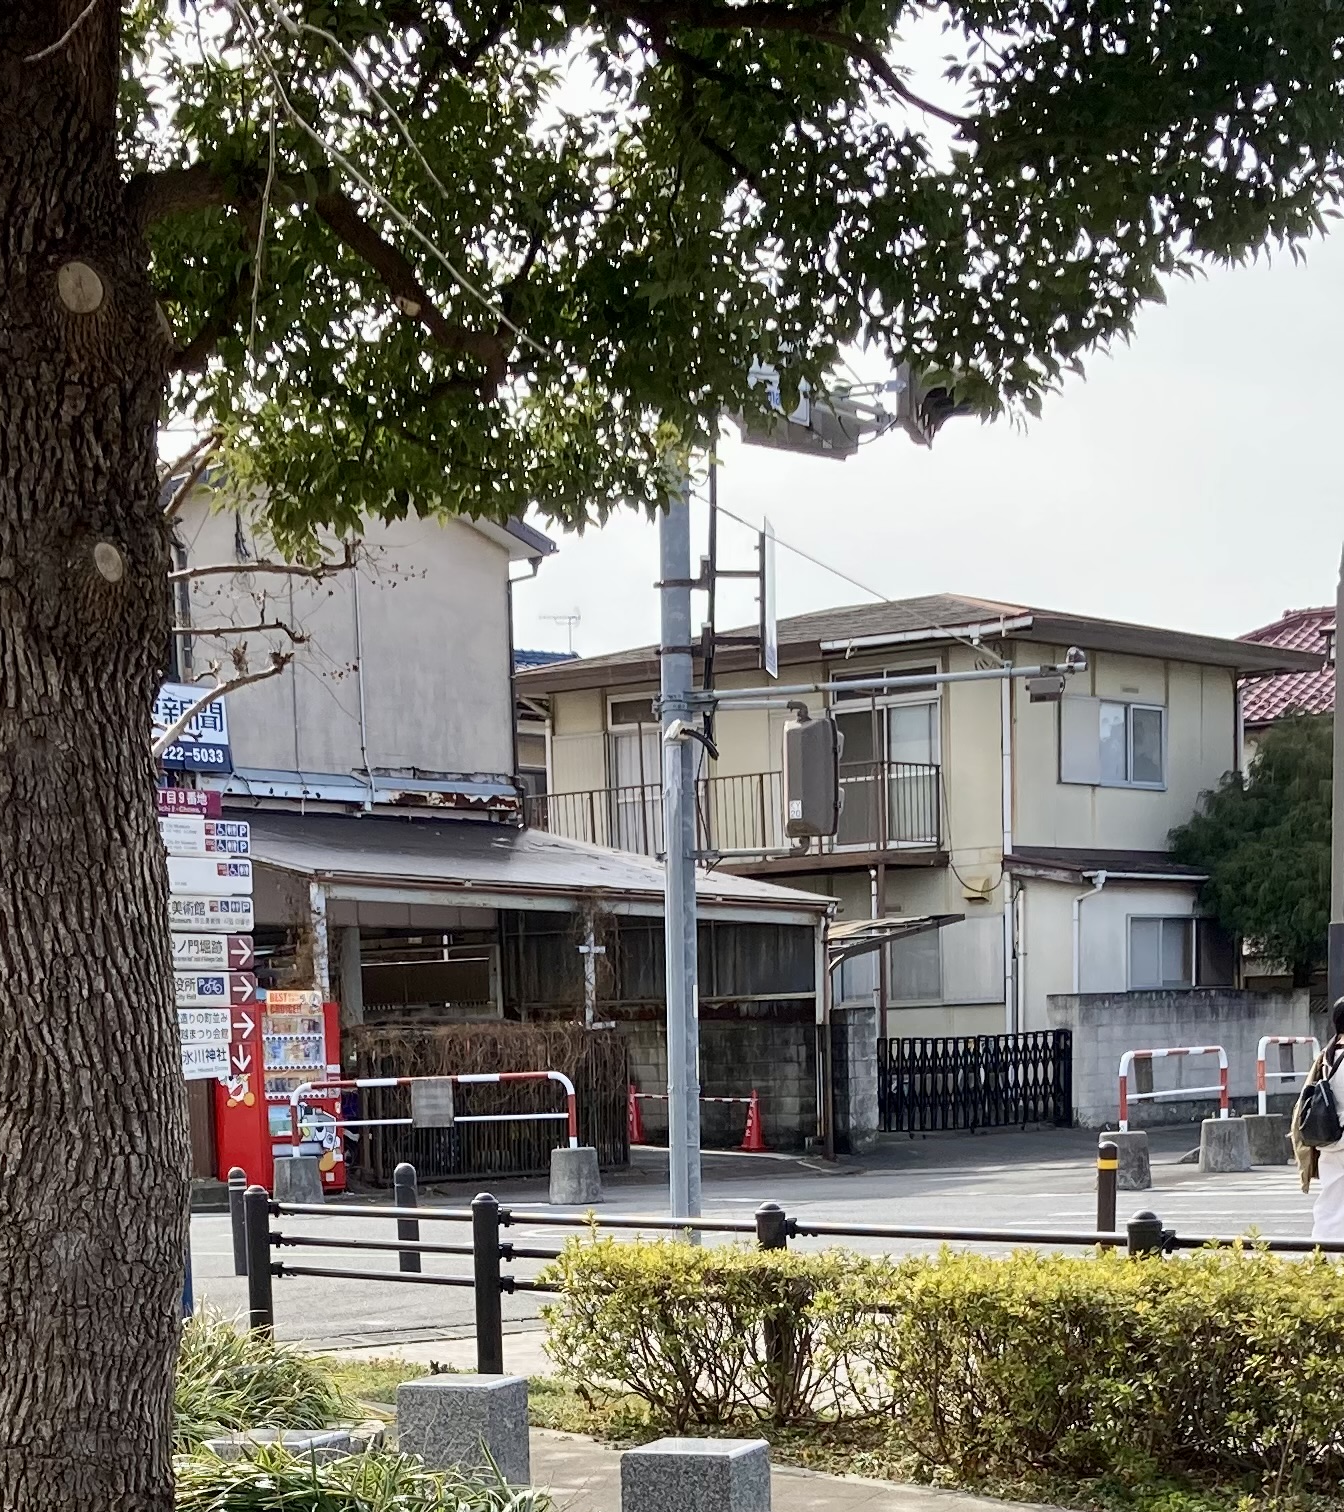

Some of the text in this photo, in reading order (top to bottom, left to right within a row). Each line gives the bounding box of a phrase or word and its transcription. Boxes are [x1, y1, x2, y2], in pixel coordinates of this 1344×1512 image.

[269, 992, 287, 1002] BEST
[182, 1048, 227, 1065] 氷川神社
